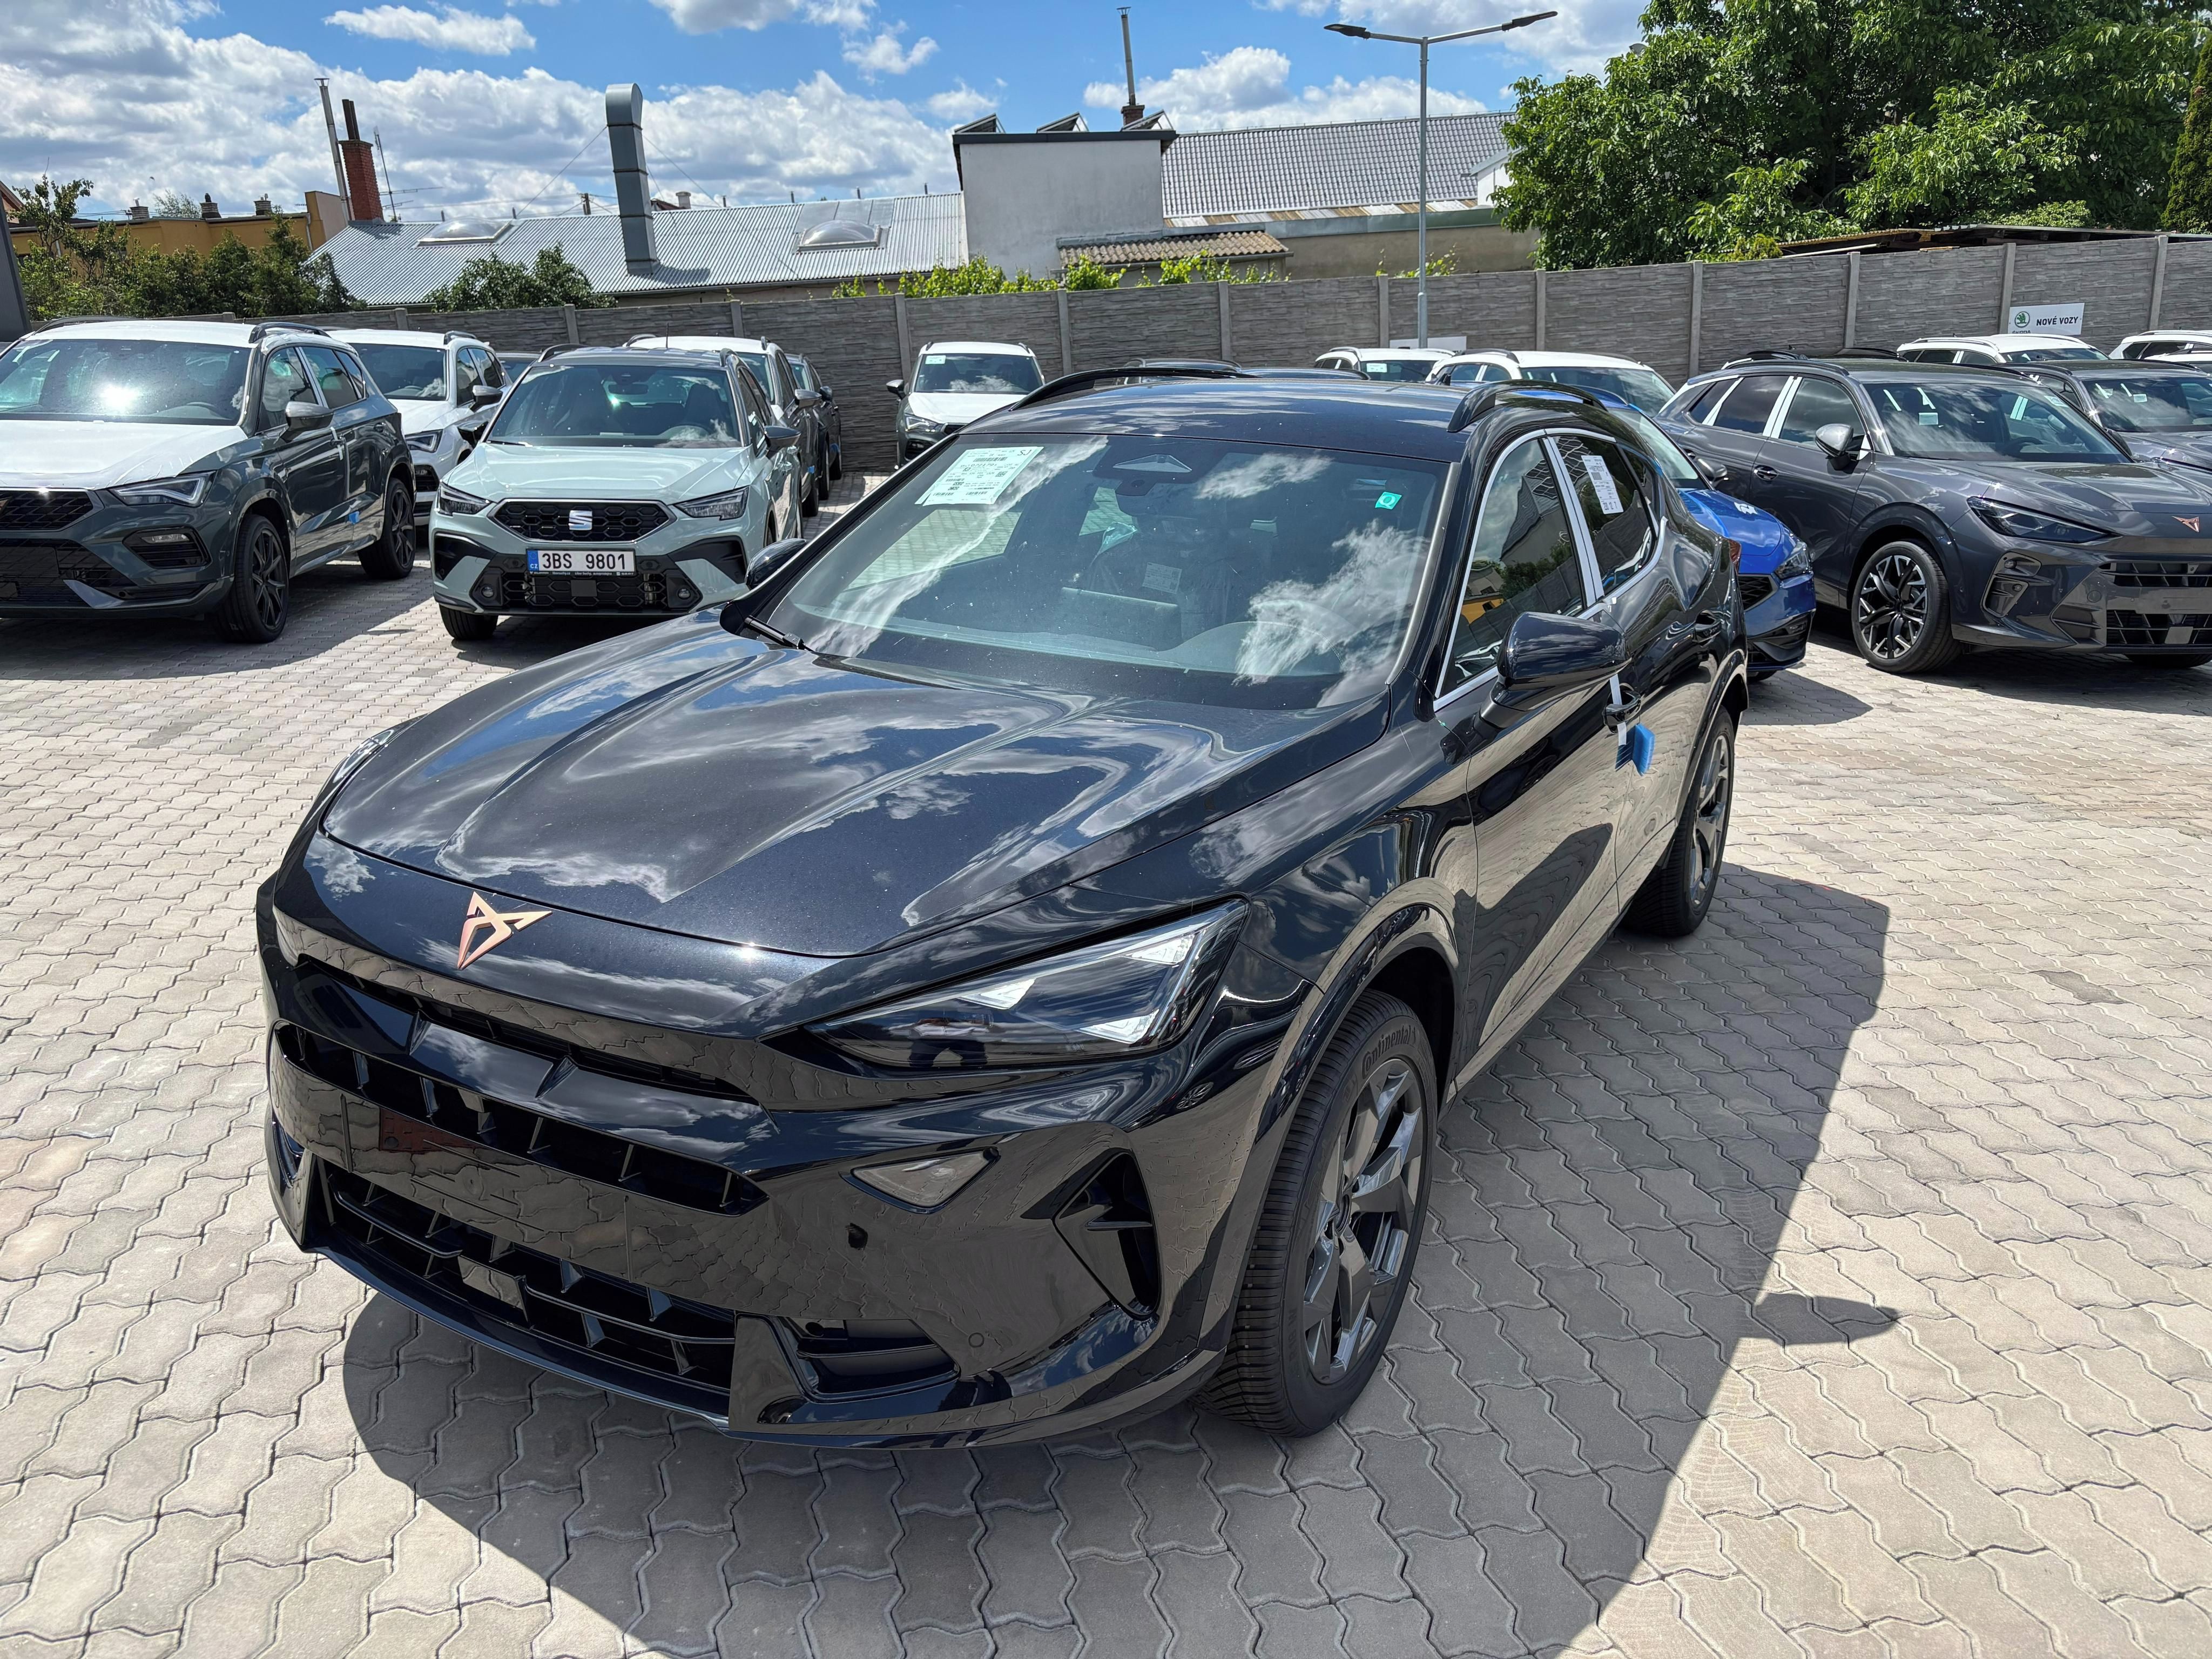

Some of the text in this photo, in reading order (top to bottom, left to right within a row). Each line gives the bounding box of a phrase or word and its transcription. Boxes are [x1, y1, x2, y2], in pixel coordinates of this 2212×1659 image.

[2036, 316, 2079, 326] NOVÉ VOZY
[1379, 494, 1396, 508] Q
[542, 553, 625, 570] 3BS 9801
[1362, 1025, 1411, 1080] Continental
